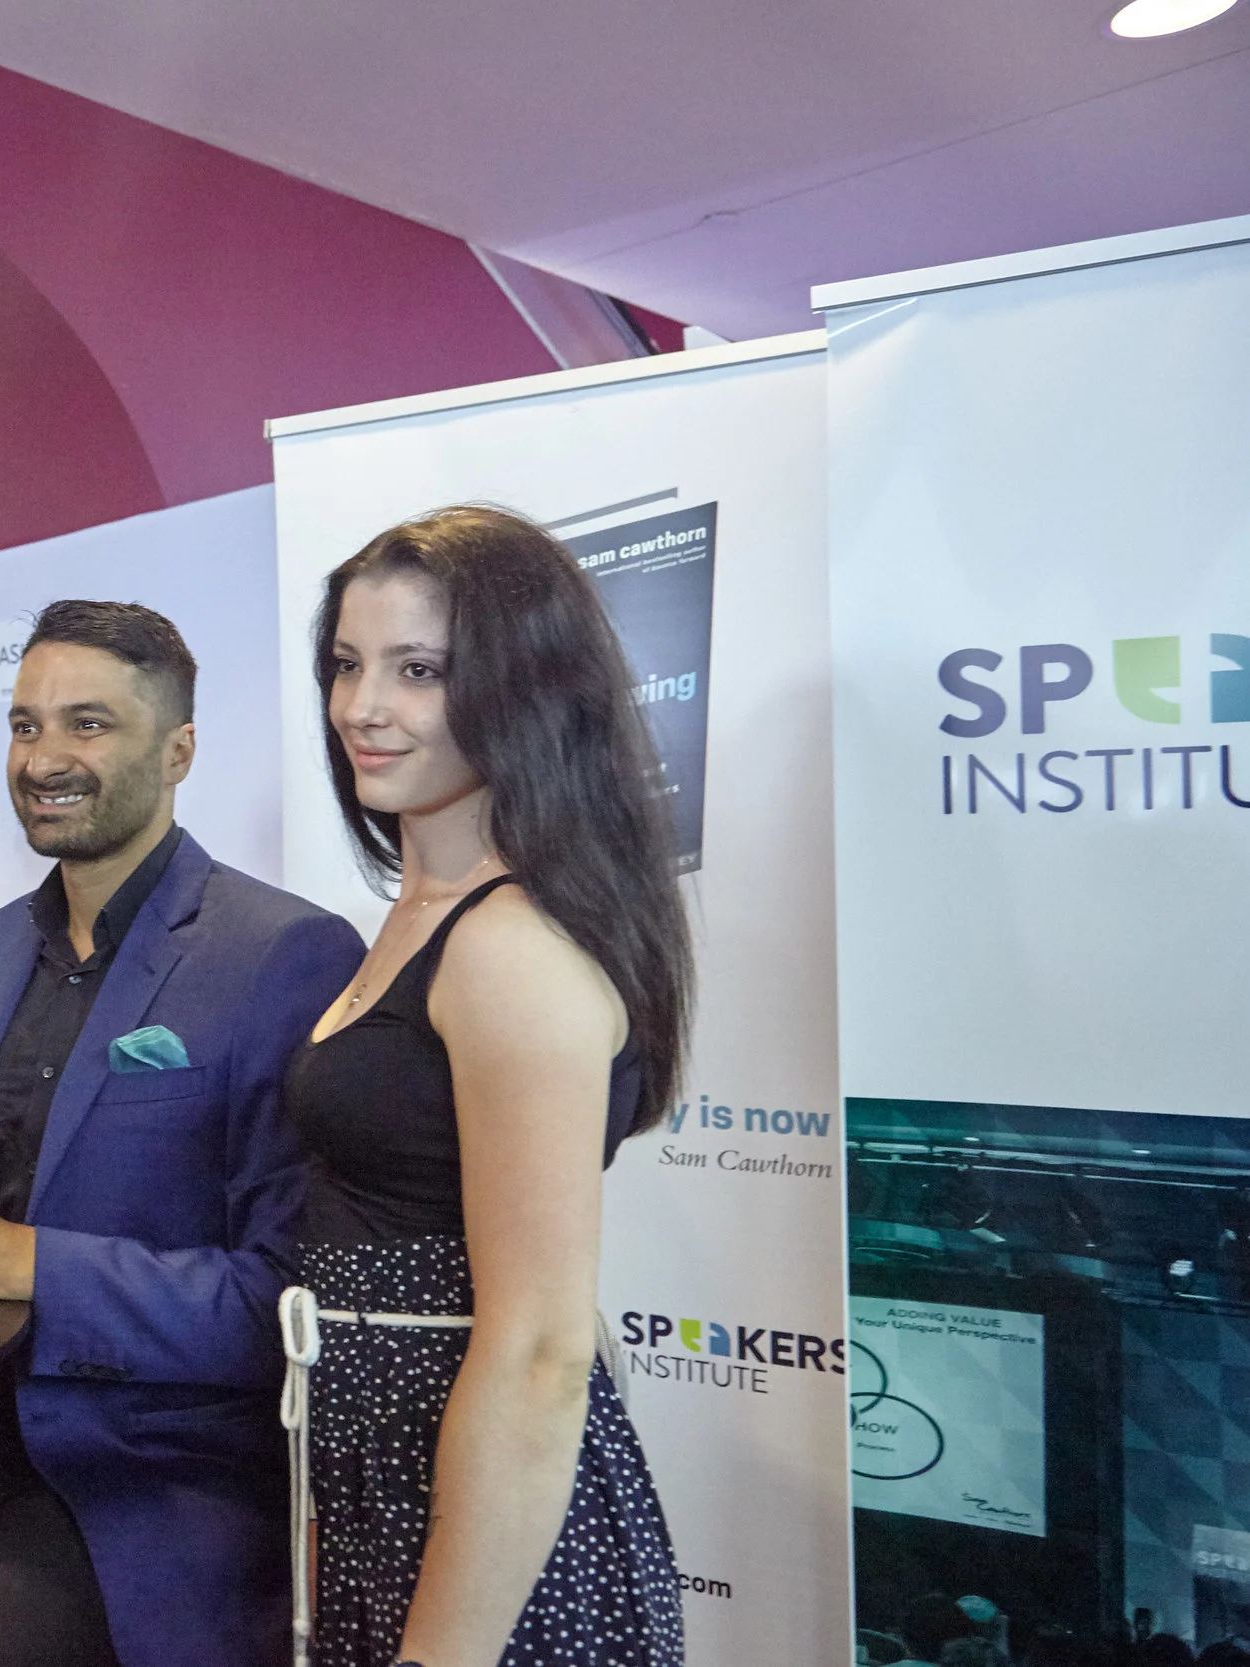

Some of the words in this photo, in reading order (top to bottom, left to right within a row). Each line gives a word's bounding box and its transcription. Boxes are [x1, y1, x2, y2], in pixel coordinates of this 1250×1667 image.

[577, 549, 616, 569] sam
[619, 526, 707, 559] cawthorn
[700, 1095, 733, 1130] is
[744, 1106, 831, 1137] now
[658, 1144, 707, 1167] Sam
[717, 1150, 833, 1179] Cawthorn
[855, 1316, 887, 1328] Your
[891, 1320, 943, 1334] Unique
[947, 1326, 1036, 1345] Perspective
[887, 1308, 946, 1322] ADDING
[951, 1314, 1002, 1328] VALUE
[621, 1311, 844, 1375] SPEAKERS
[626, 1350, 768, 1394] NSTITUTE
[855, 1422, 899, 1435] HOW
